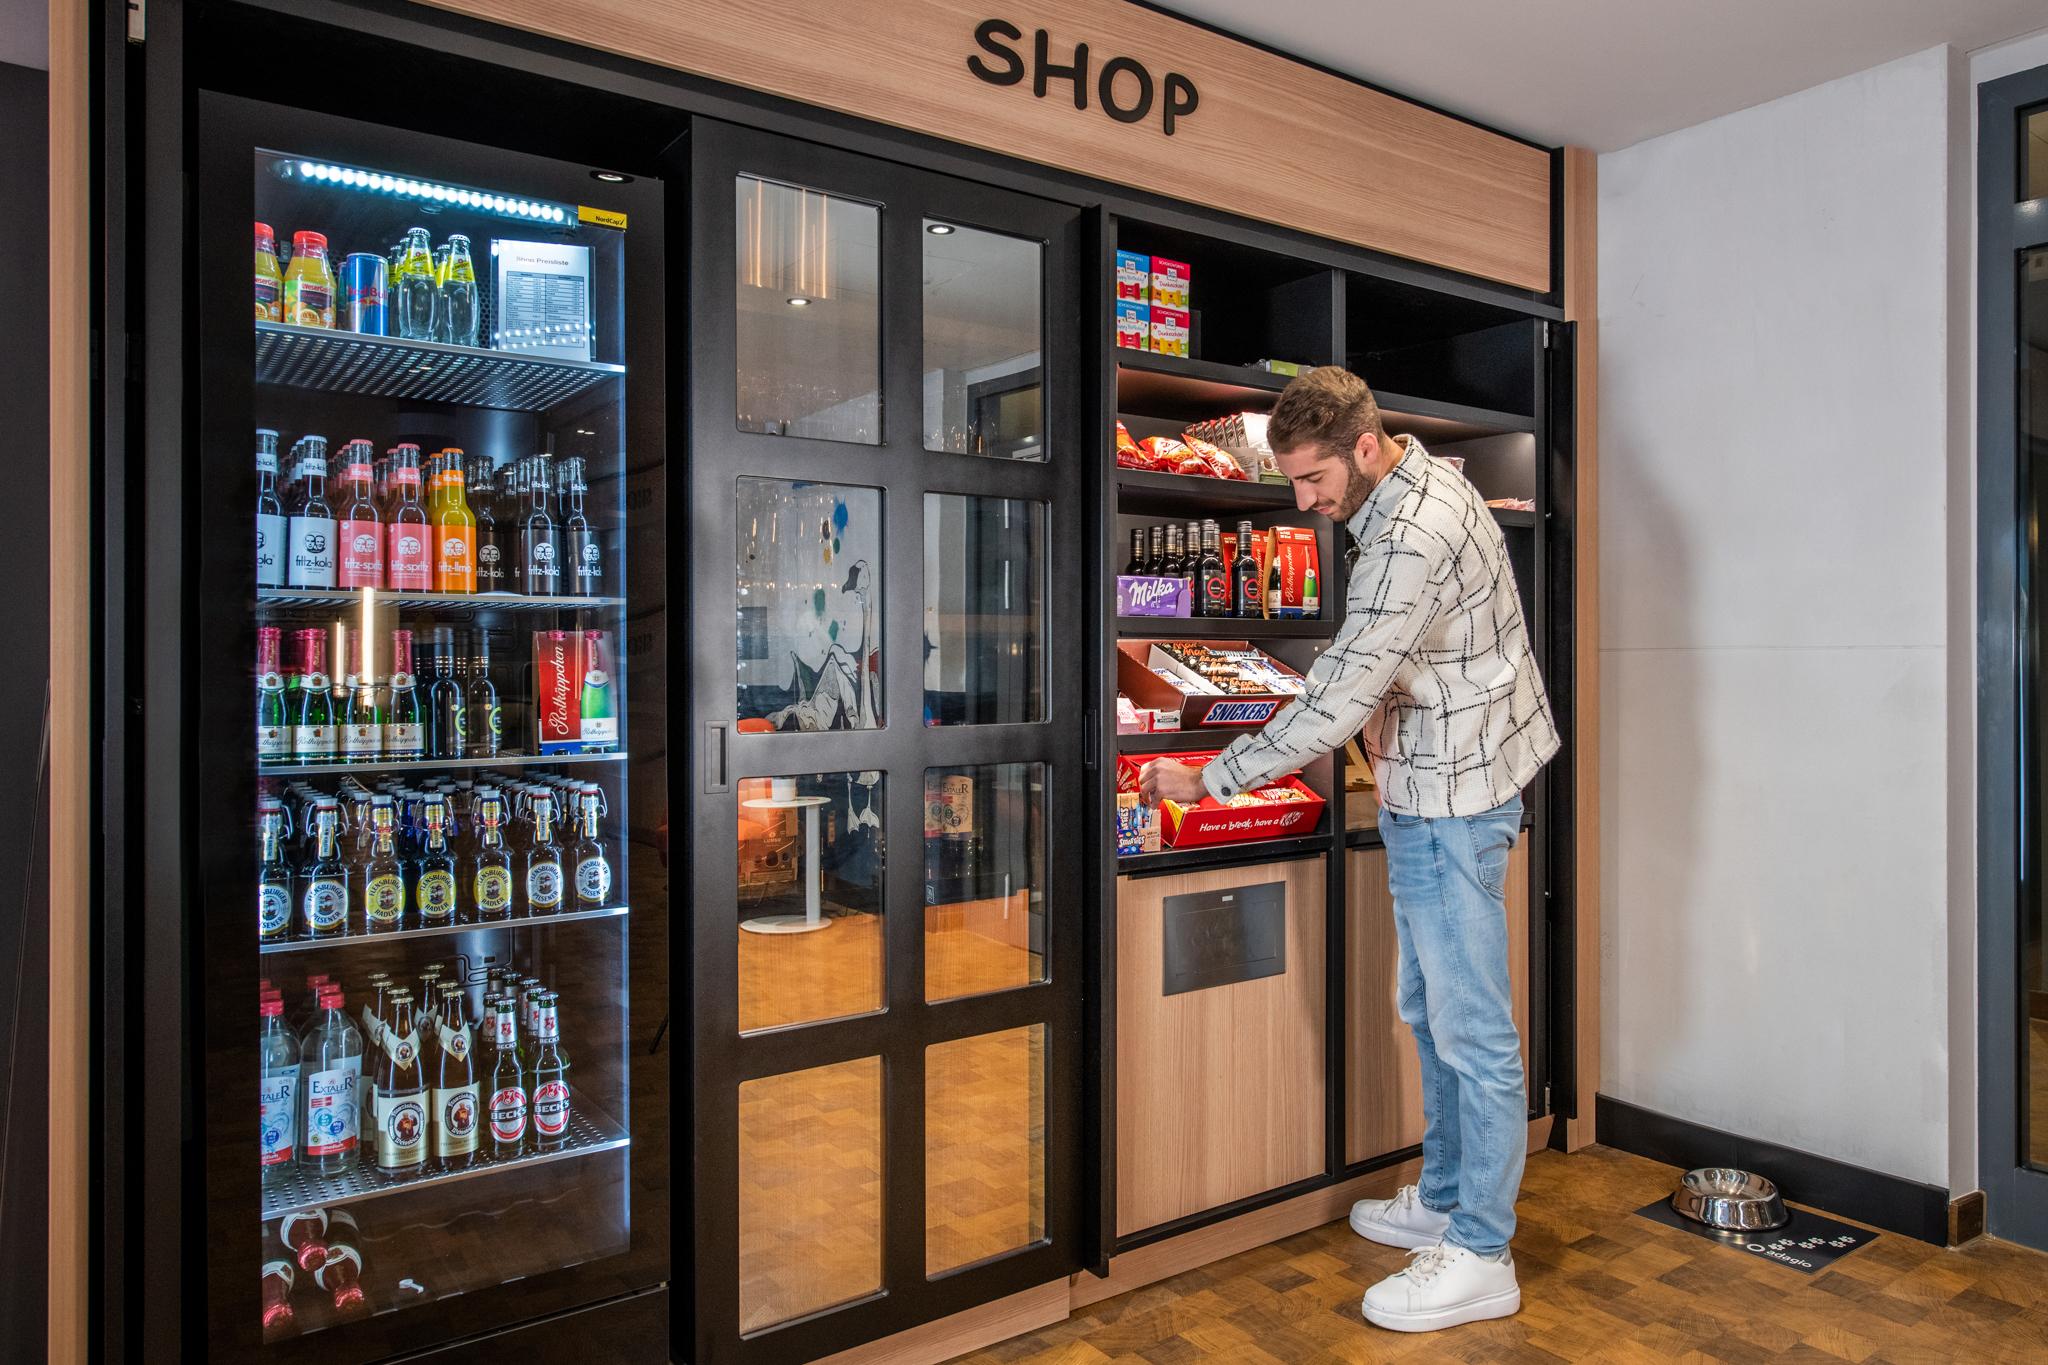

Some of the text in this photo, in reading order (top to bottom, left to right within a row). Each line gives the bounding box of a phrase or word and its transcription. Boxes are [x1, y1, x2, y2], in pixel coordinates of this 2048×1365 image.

[967, 19, 1199, 136] SHOP
[595, 215, 620, 225] NordCap
[536, 257, 569, 266] Preisliste
[296, 554, 333, 568] fritz-kola
[528, 565, 560, 576] fritz-kola
[1128, 578, 1175, 606] Milka
[548, 646, 571, 735] Rotkäppchen
[1206, 703, 1276, 721] SNICKERS
[1199, 823, 1220, 832] Have
[1228, 819, 1253, 831] break,
[1254, 819, 1274, 827] have
[481, 897, 505, 907] RADLER
[532, 890, 559, 902] PILSENER
[374, 908, 399, 919] RADLER
[424, 902, 450, 913] RADLER
[313, 1077, 353, 1094] EXTALER
[261, 1085, 290, 1100] TALER
[1766, 1250, 1812, 1267] adagio
